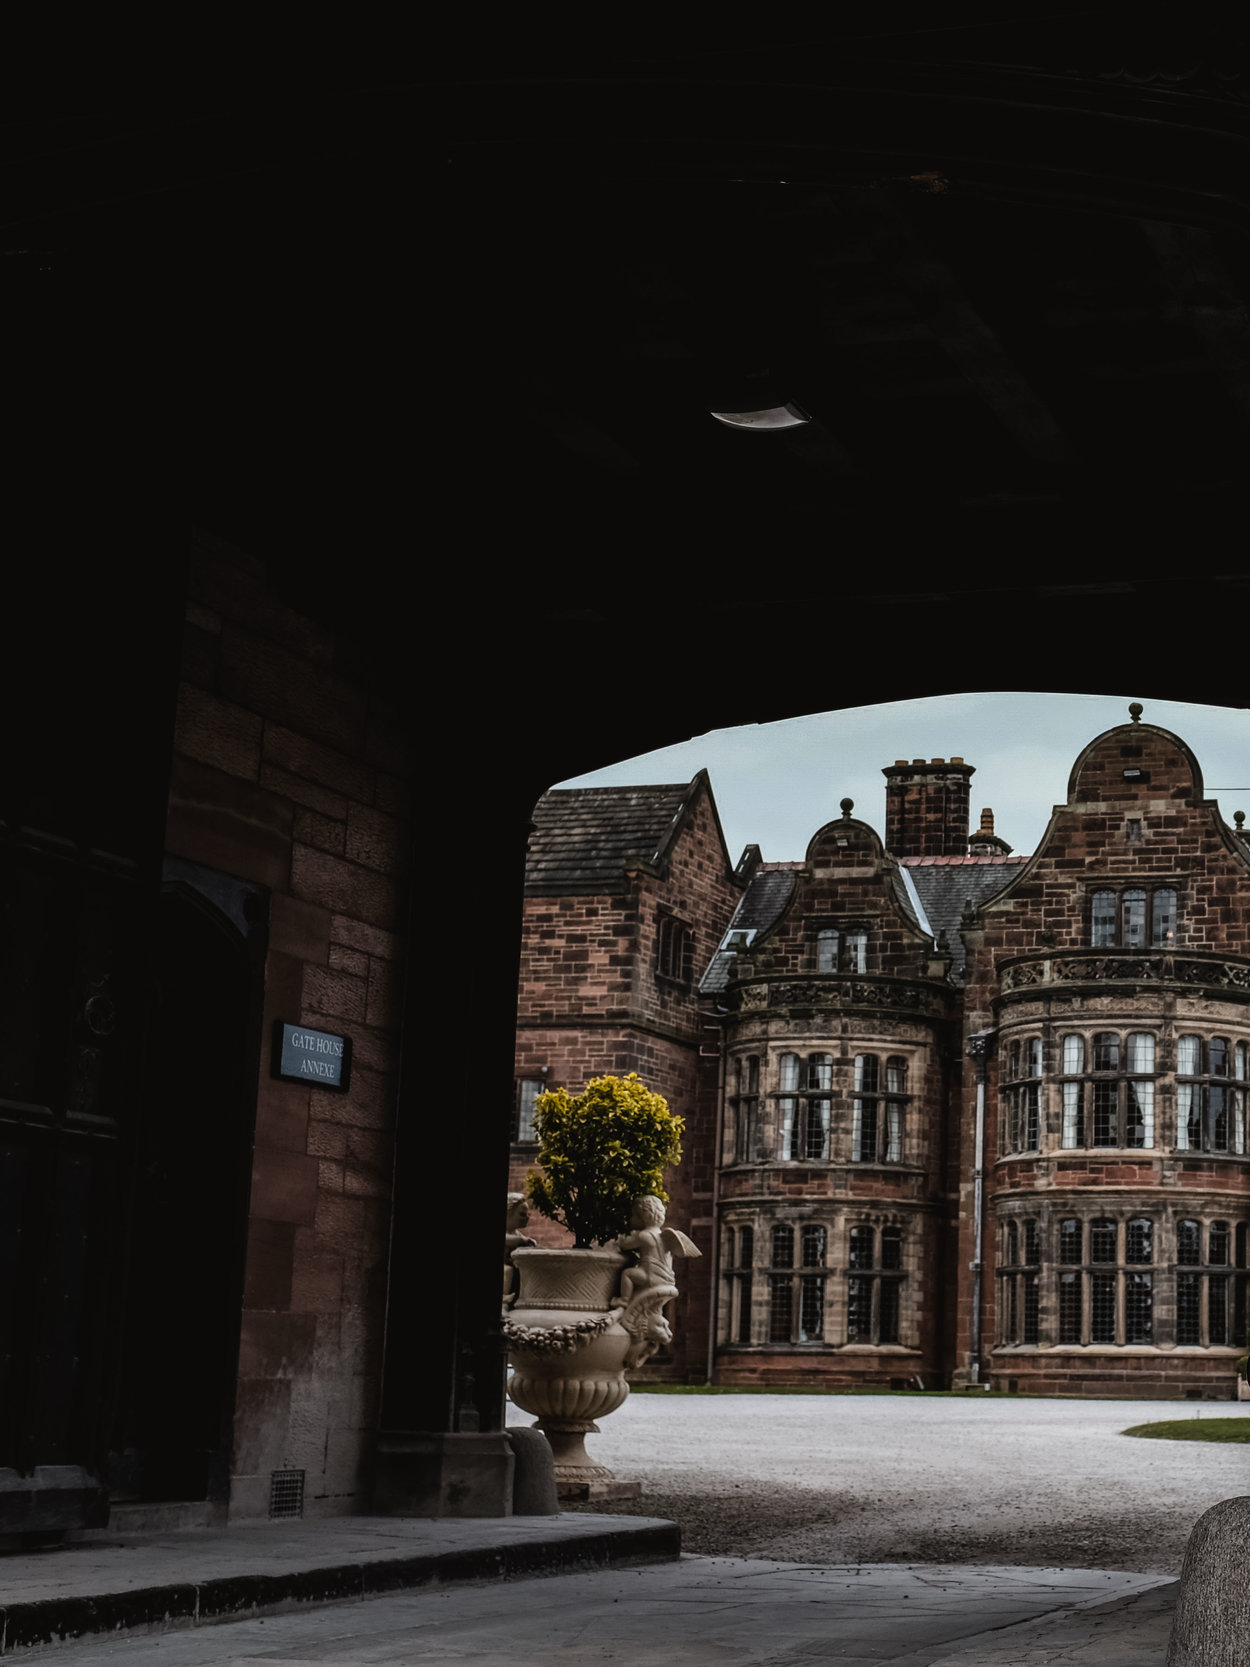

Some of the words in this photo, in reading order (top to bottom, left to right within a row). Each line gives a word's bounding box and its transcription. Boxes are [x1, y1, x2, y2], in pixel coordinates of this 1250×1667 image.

[292, 1033, 315, 1051] GATE
[316, 1038, 344, 1057] HOUSE
[301, 1059, 335, 1078] ANNEXE
